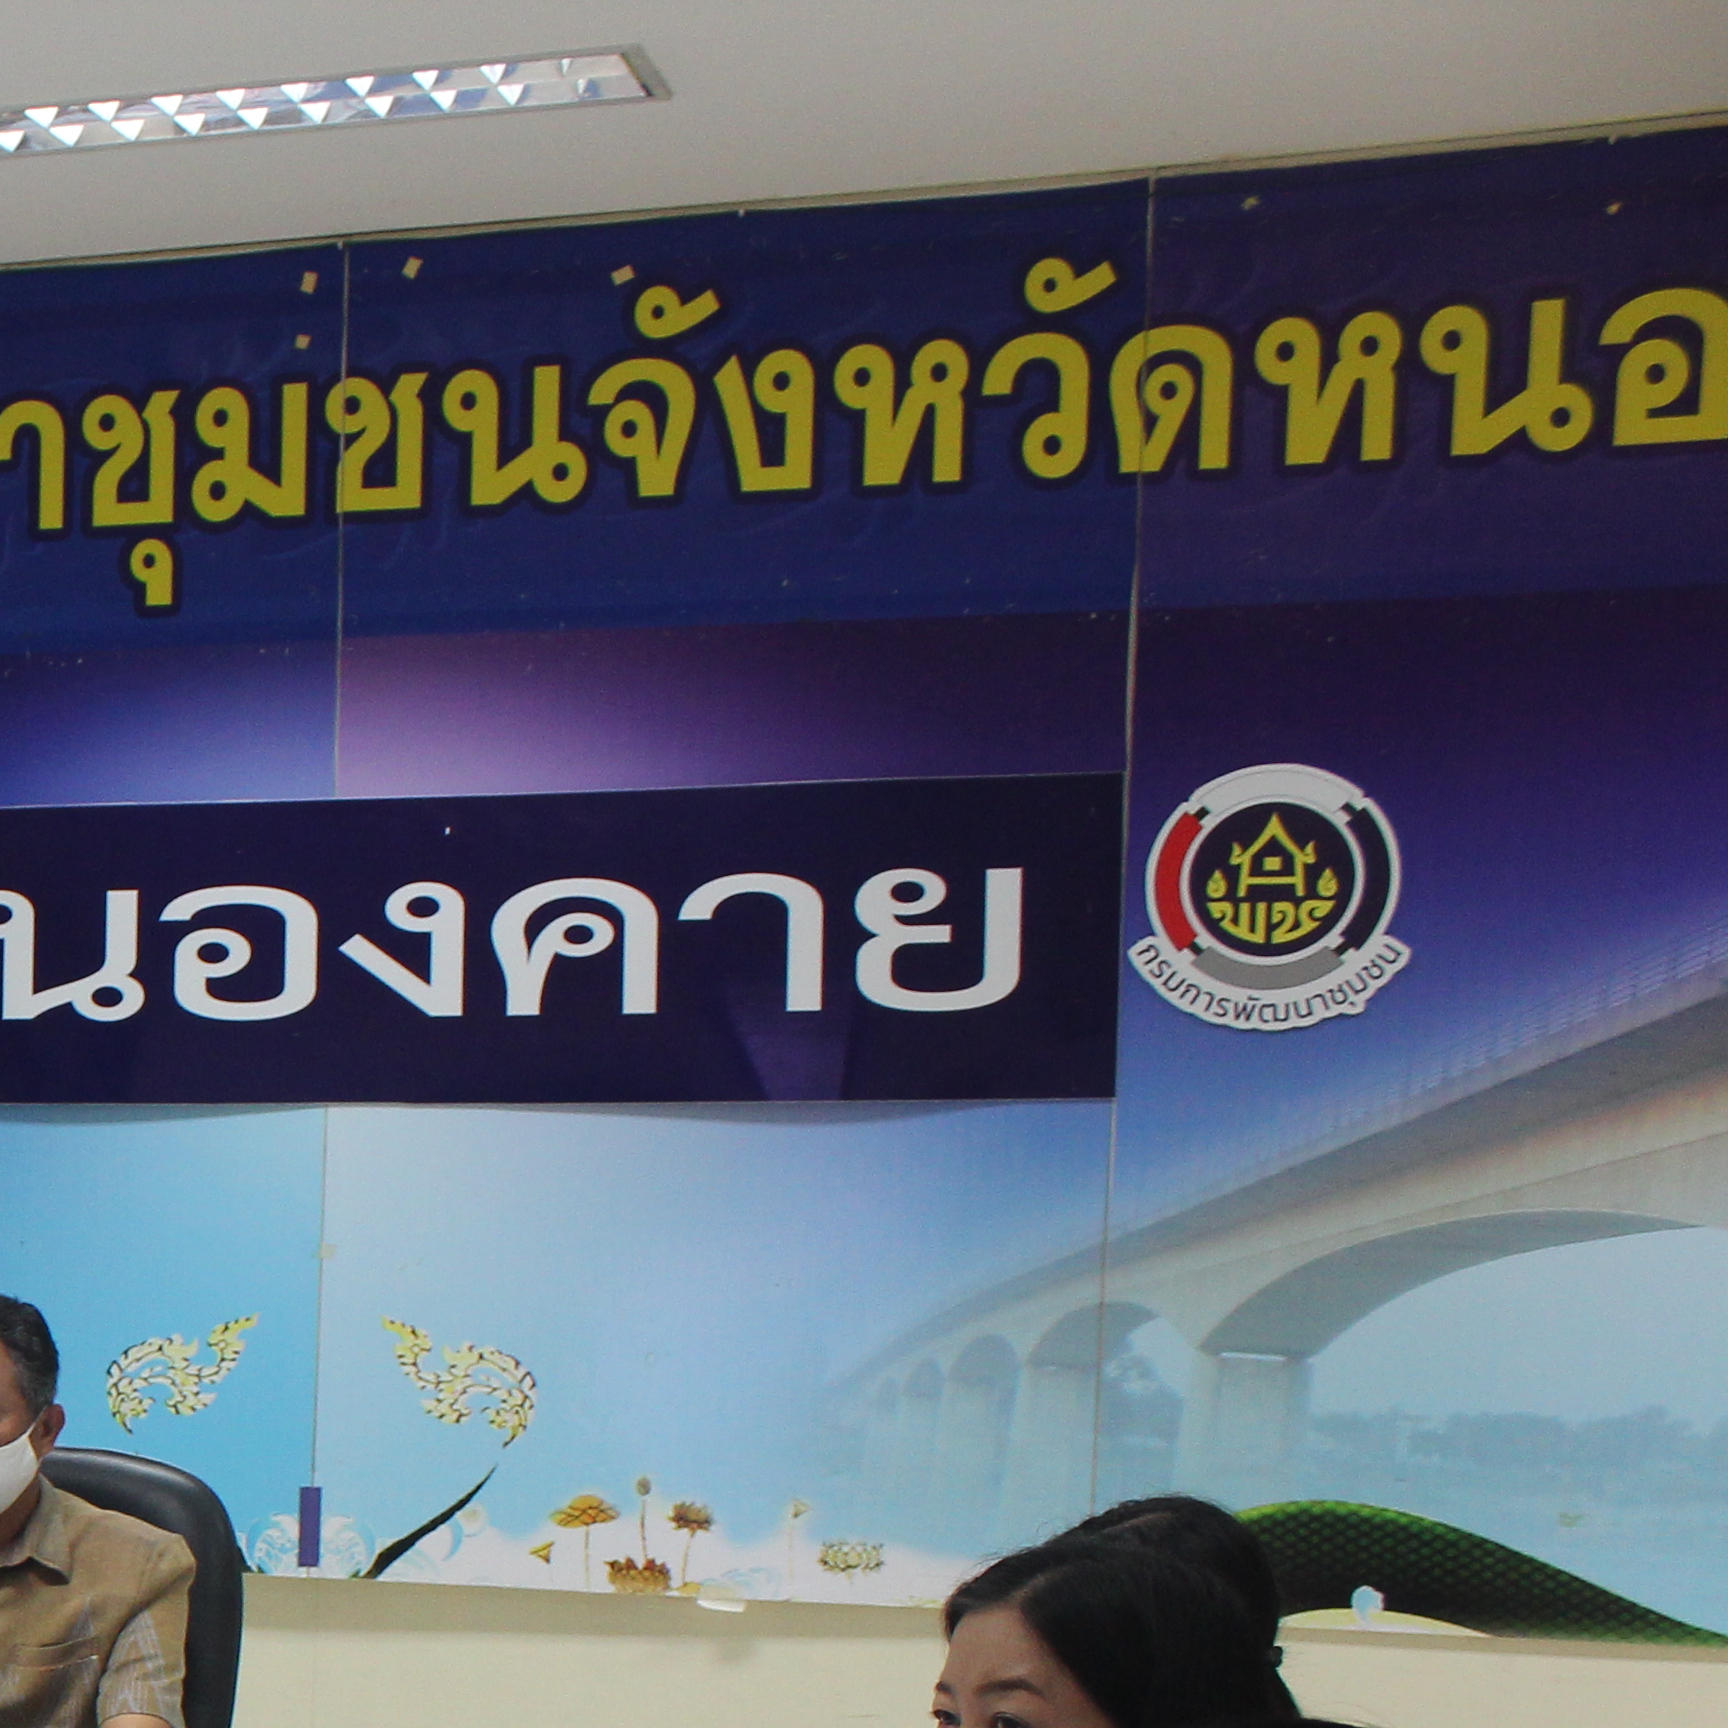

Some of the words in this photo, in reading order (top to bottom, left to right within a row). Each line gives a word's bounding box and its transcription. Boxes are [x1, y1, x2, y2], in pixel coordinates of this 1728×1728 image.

[1137, 943, 1402, 1024] กรมการพัฒนาชุมชน
